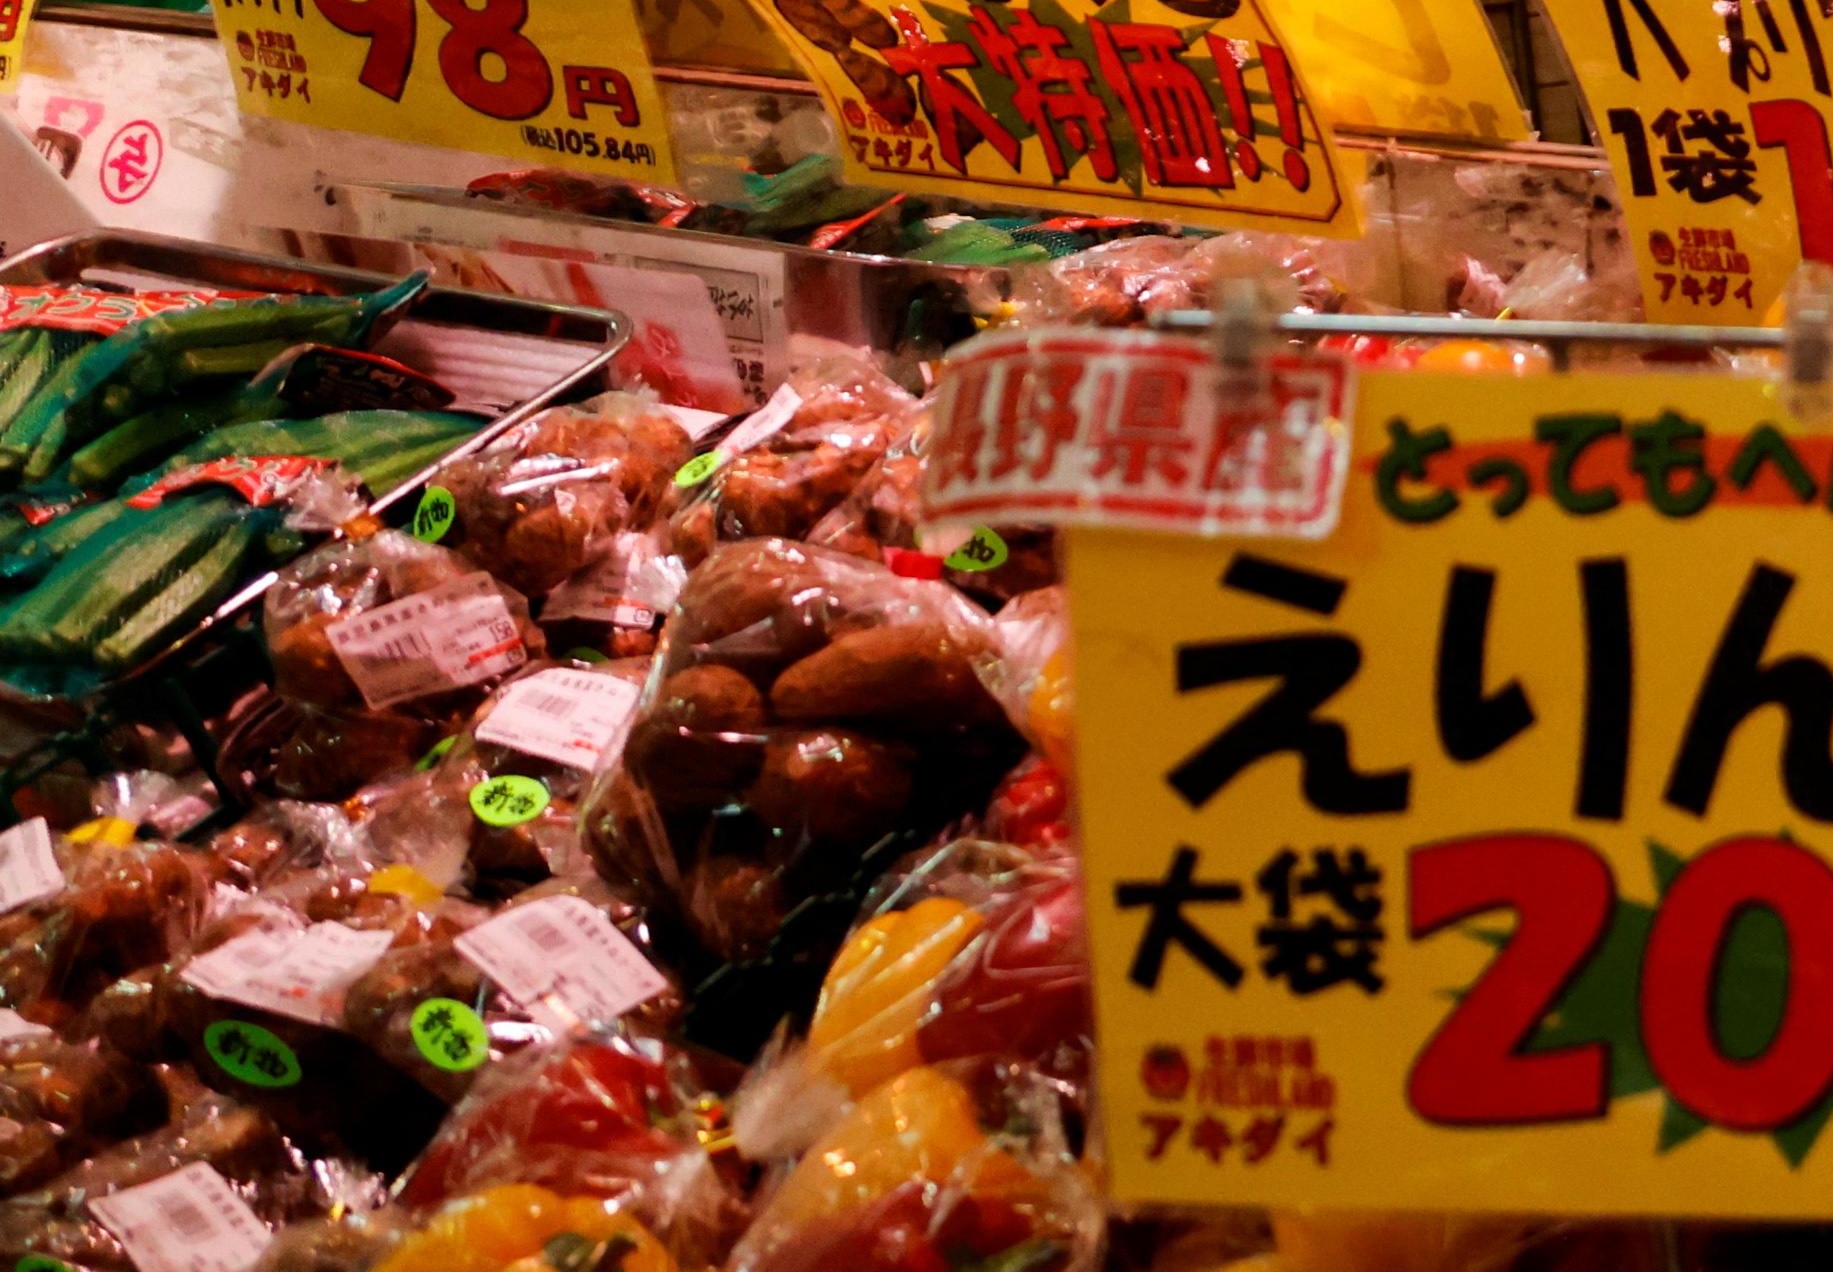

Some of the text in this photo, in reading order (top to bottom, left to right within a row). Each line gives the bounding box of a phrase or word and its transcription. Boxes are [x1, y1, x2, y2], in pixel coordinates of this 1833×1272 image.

[239, 66, 311, 103] アキダイ
[1607, 107, 1763, 205] 1袋
[1653, 273, 1754, 309] アキダイ
[1114, 843, 1389, 996] 大袋
[1139, 1112, 1334, 1168] アキダイ
